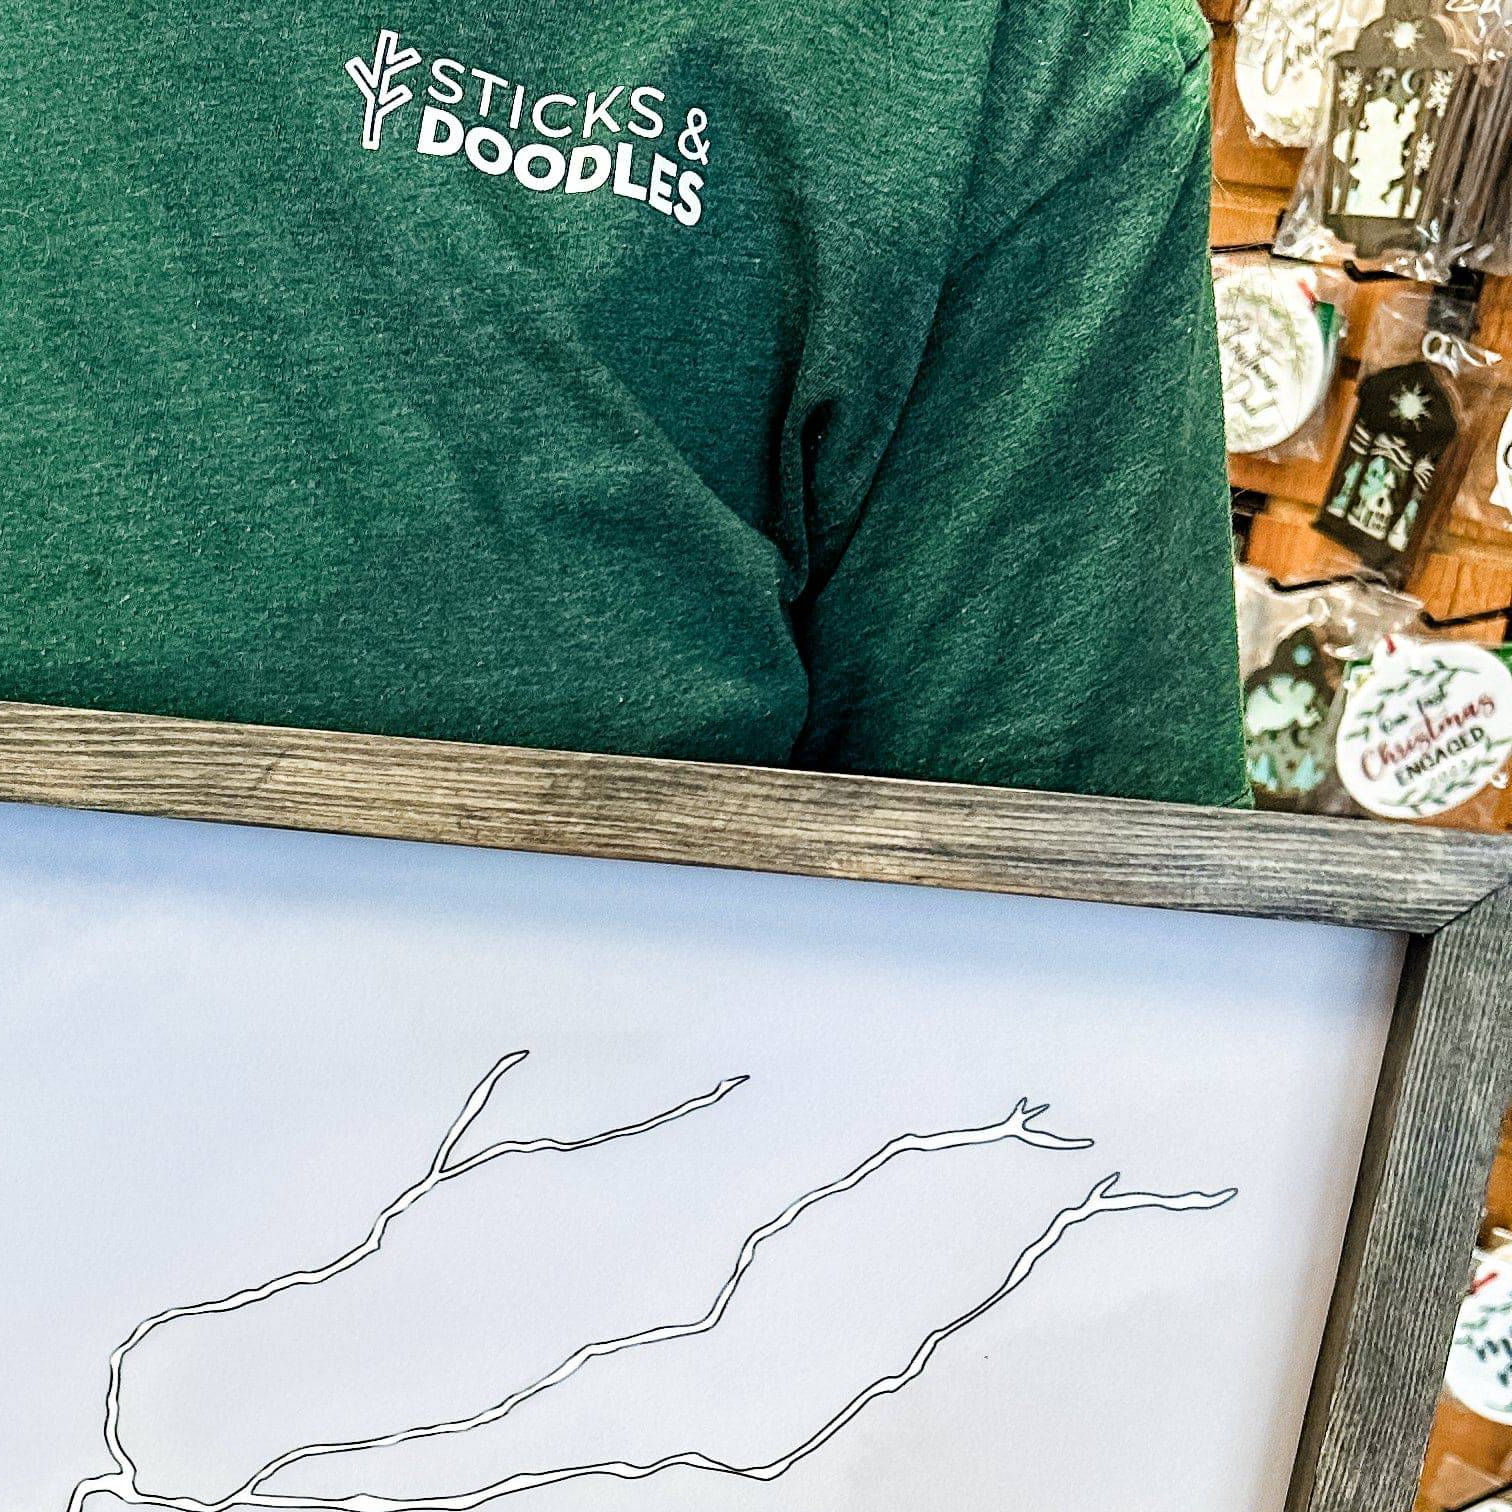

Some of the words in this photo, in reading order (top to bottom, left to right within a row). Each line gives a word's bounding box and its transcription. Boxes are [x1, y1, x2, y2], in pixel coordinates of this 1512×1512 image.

[416, 105, 705, 226] DOODLES
[427, 58, 666, 139] STICKS
[678, 107, 711, 166] &
[1394, 726, 1484, 787] ENGAGED
